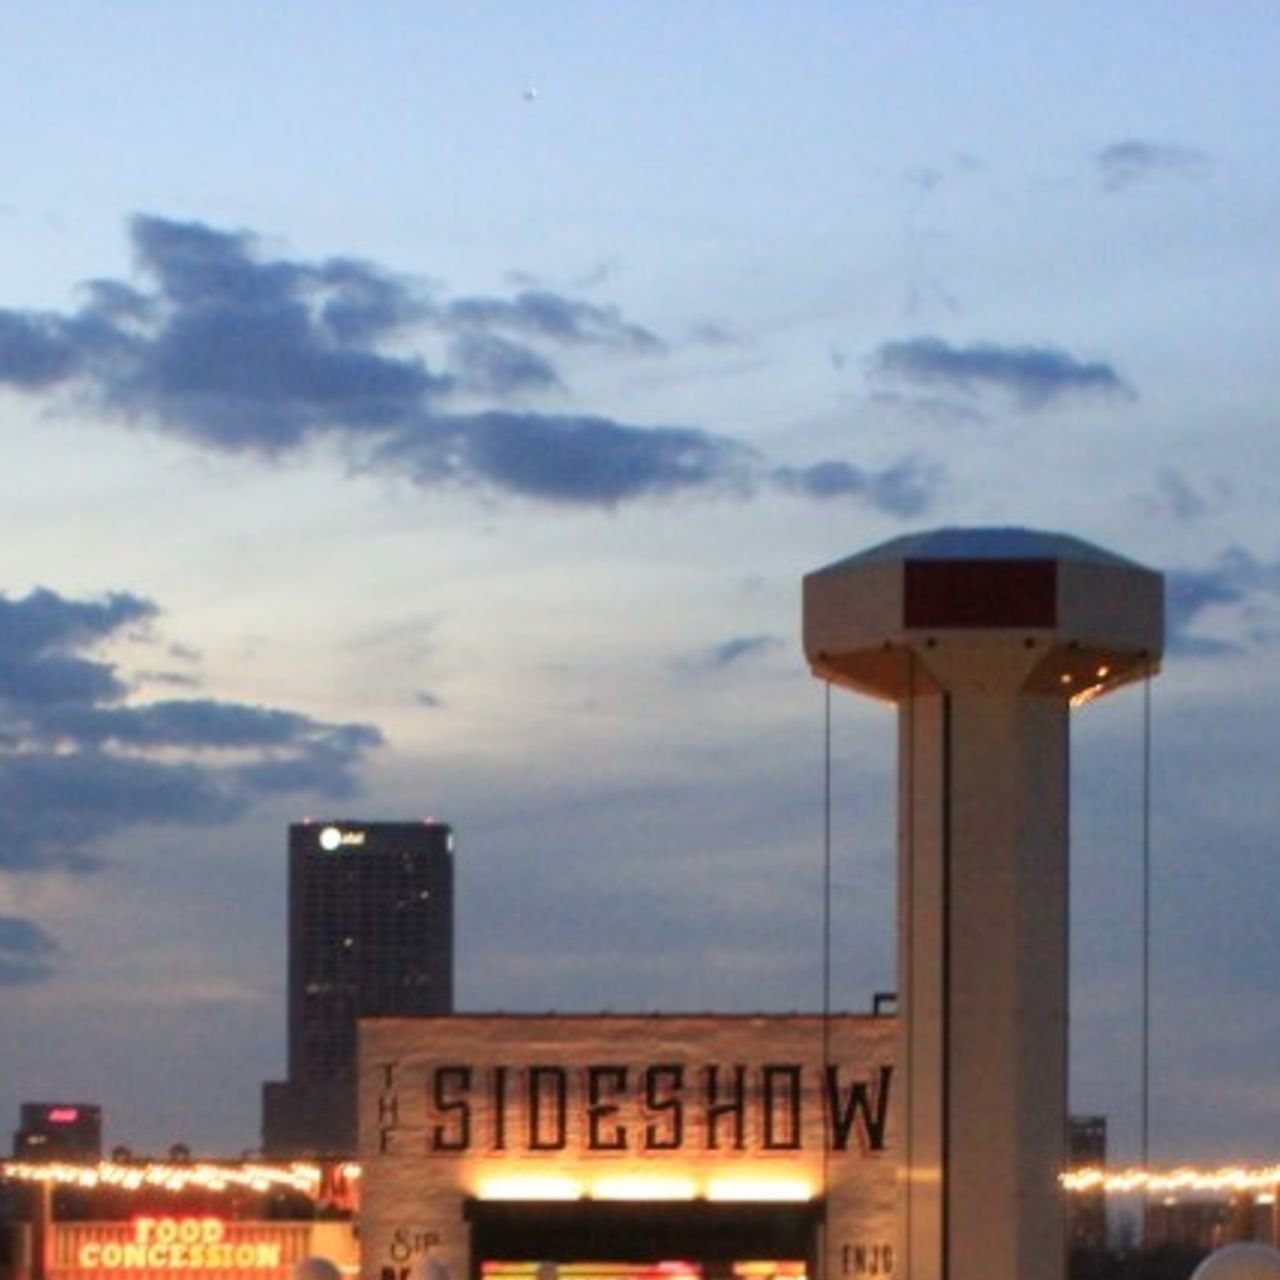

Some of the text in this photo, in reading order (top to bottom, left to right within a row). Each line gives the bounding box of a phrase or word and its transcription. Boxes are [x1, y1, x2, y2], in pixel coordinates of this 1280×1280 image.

[377, 1063, 399, 1154] THE
[432, 1064, 893, 1152] SIDESHOW
[79, 1243, 281, 1268] CONCESSION
[134, 1217, 225, 1244] FOOD
